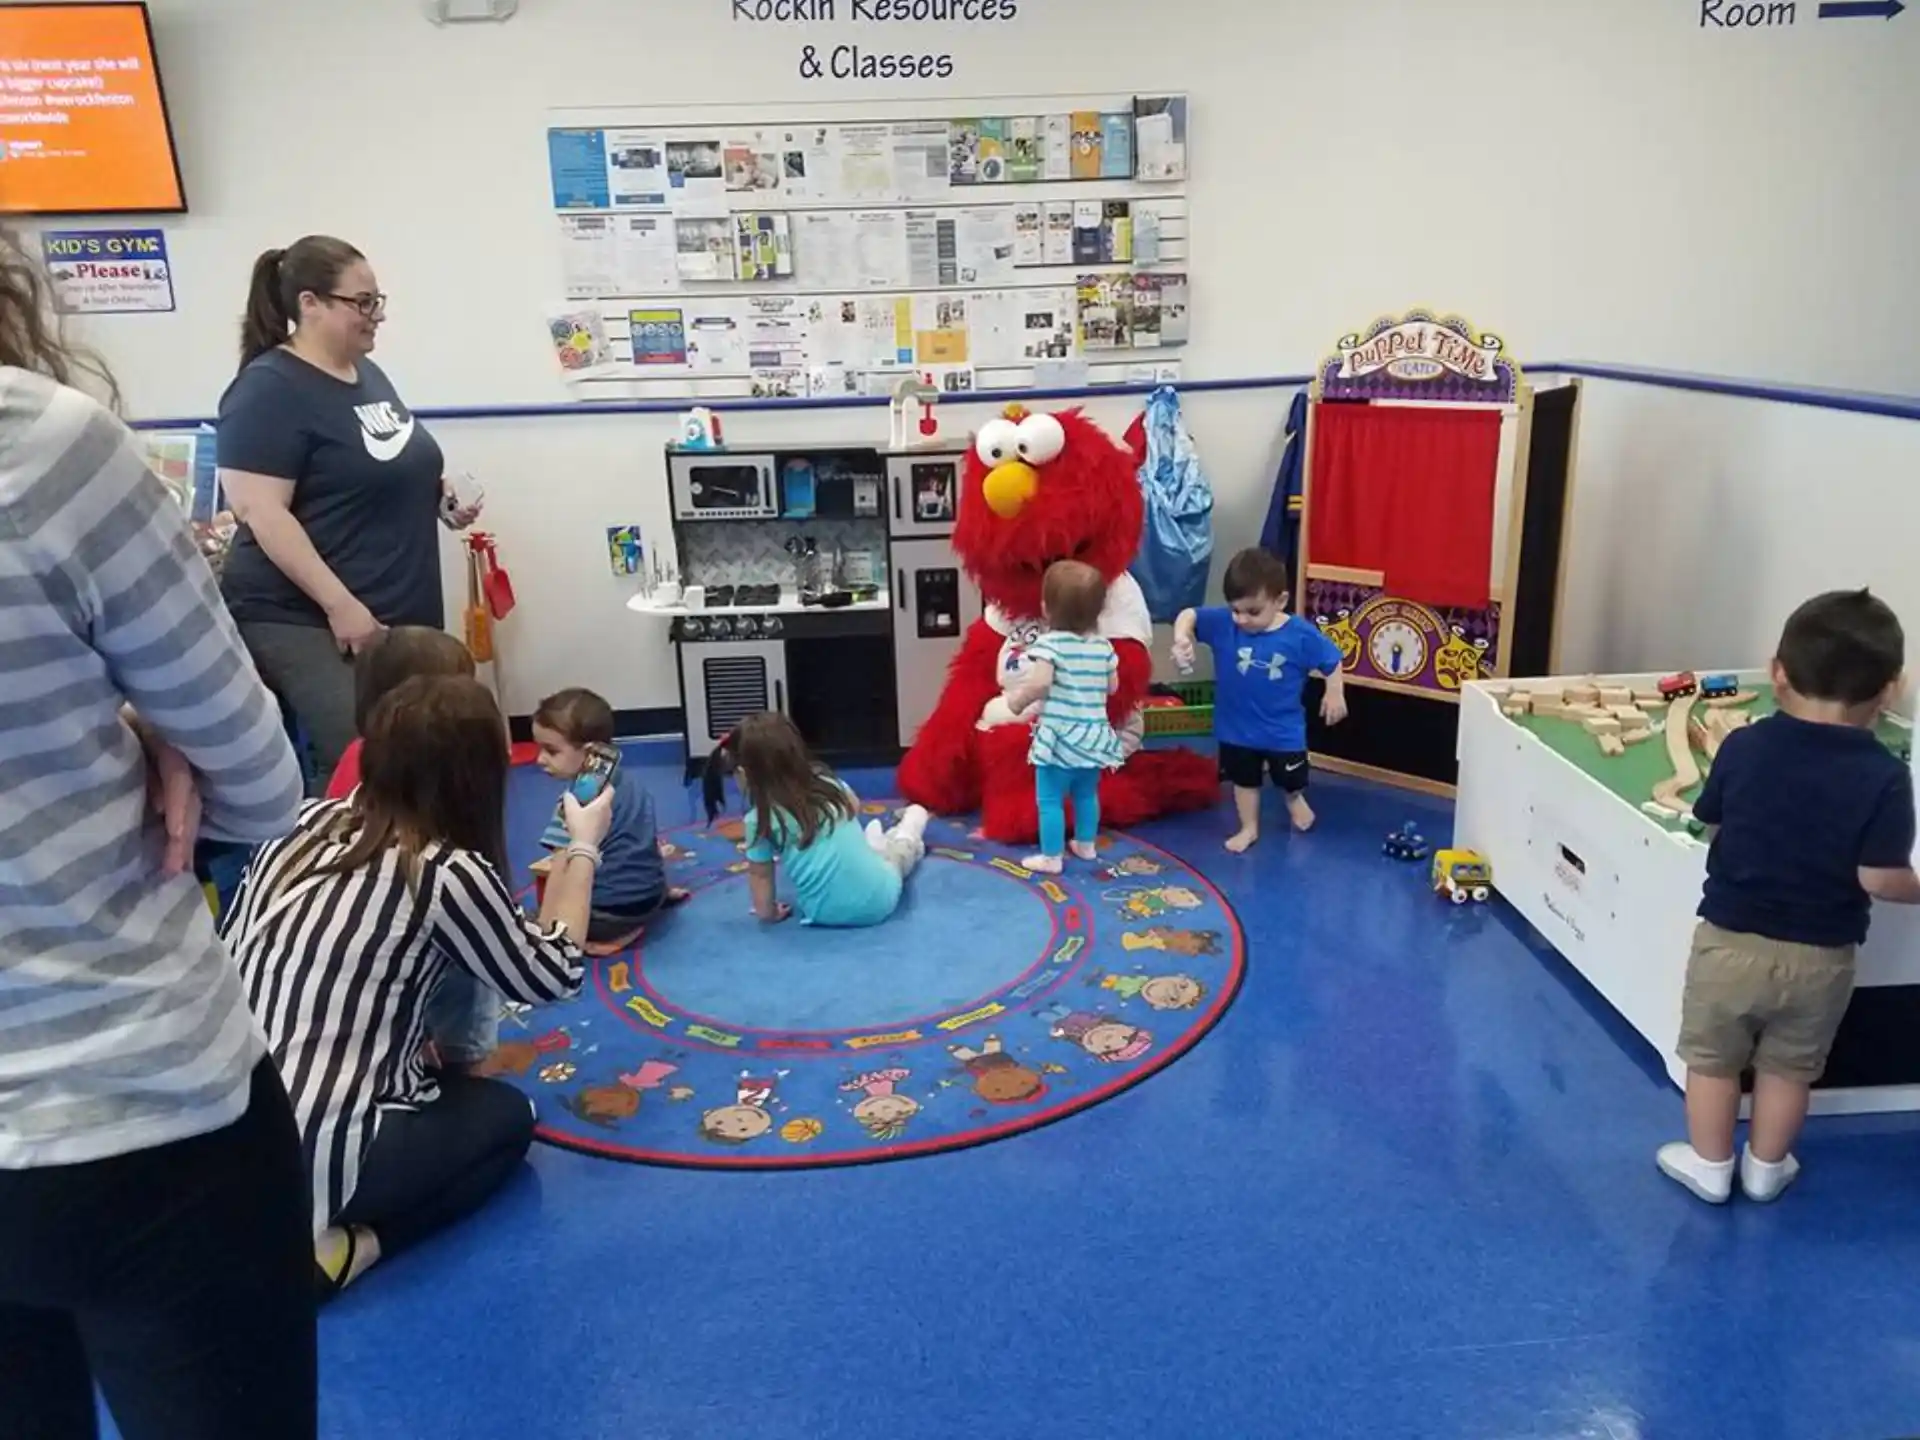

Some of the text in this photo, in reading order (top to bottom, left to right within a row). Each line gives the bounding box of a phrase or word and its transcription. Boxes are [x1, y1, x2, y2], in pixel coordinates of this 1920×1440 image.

[732, 0, 1017, 21] Rockin Resources
[1699, 0, 1796, 27] Room
[799, 45, 953, 79] & Classes
[48, 238, 100, 254] KID'S
[75, 263, 140, 278] Please
